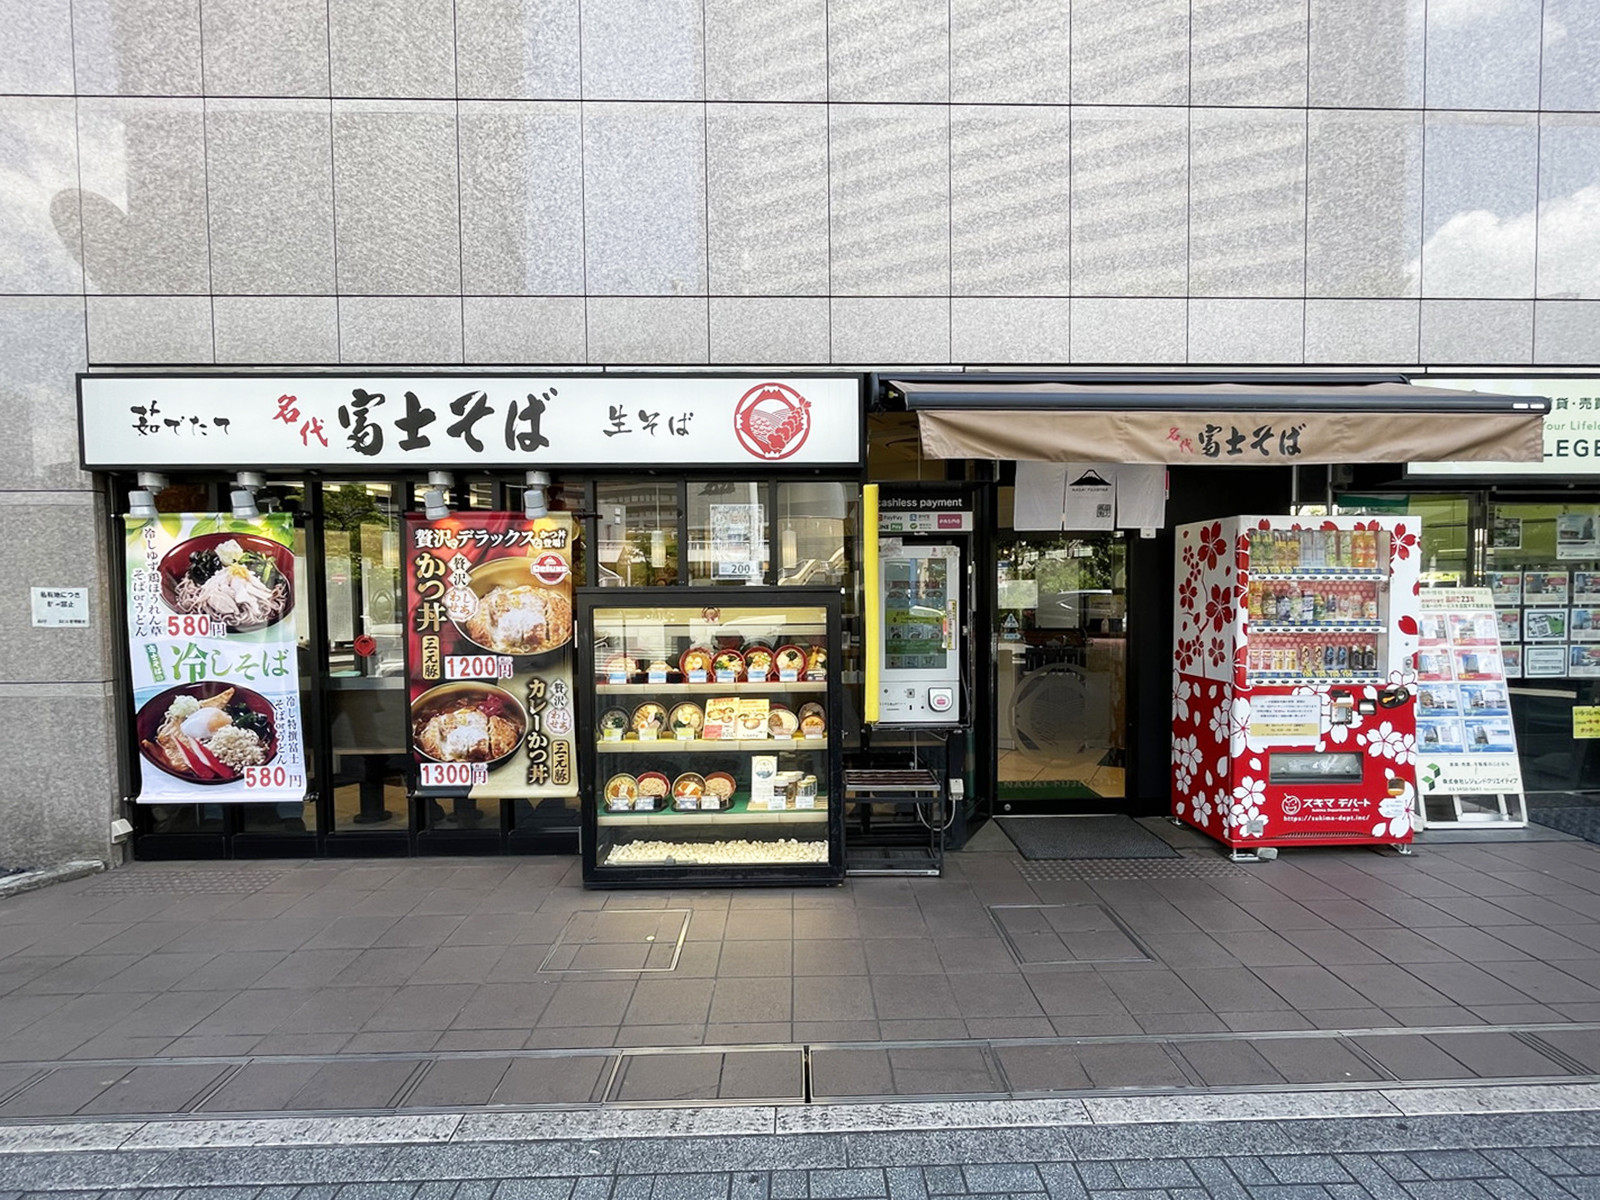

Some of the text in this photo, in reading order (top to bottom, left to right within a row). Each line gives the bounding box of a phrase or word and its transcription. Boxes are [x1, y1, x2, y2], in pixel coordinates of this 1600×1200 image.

[130, 388, 694, 456] 茹でたて 名代 富士そば 生そば
[1166, 423, 1306, 458] 名代 富士そば
[920, 499, 962, 508] payment
[731, 564, 750, 574] 200
[133, 569, 148, 637] そばorうどん
[415, 553, 447, 632] かつ丼
[171, 642, 289, 683] 冷しそば
[528, 679, 548, 784] カレーかつ丼
[1303, 798, 1371, 808] スキマ デパート
